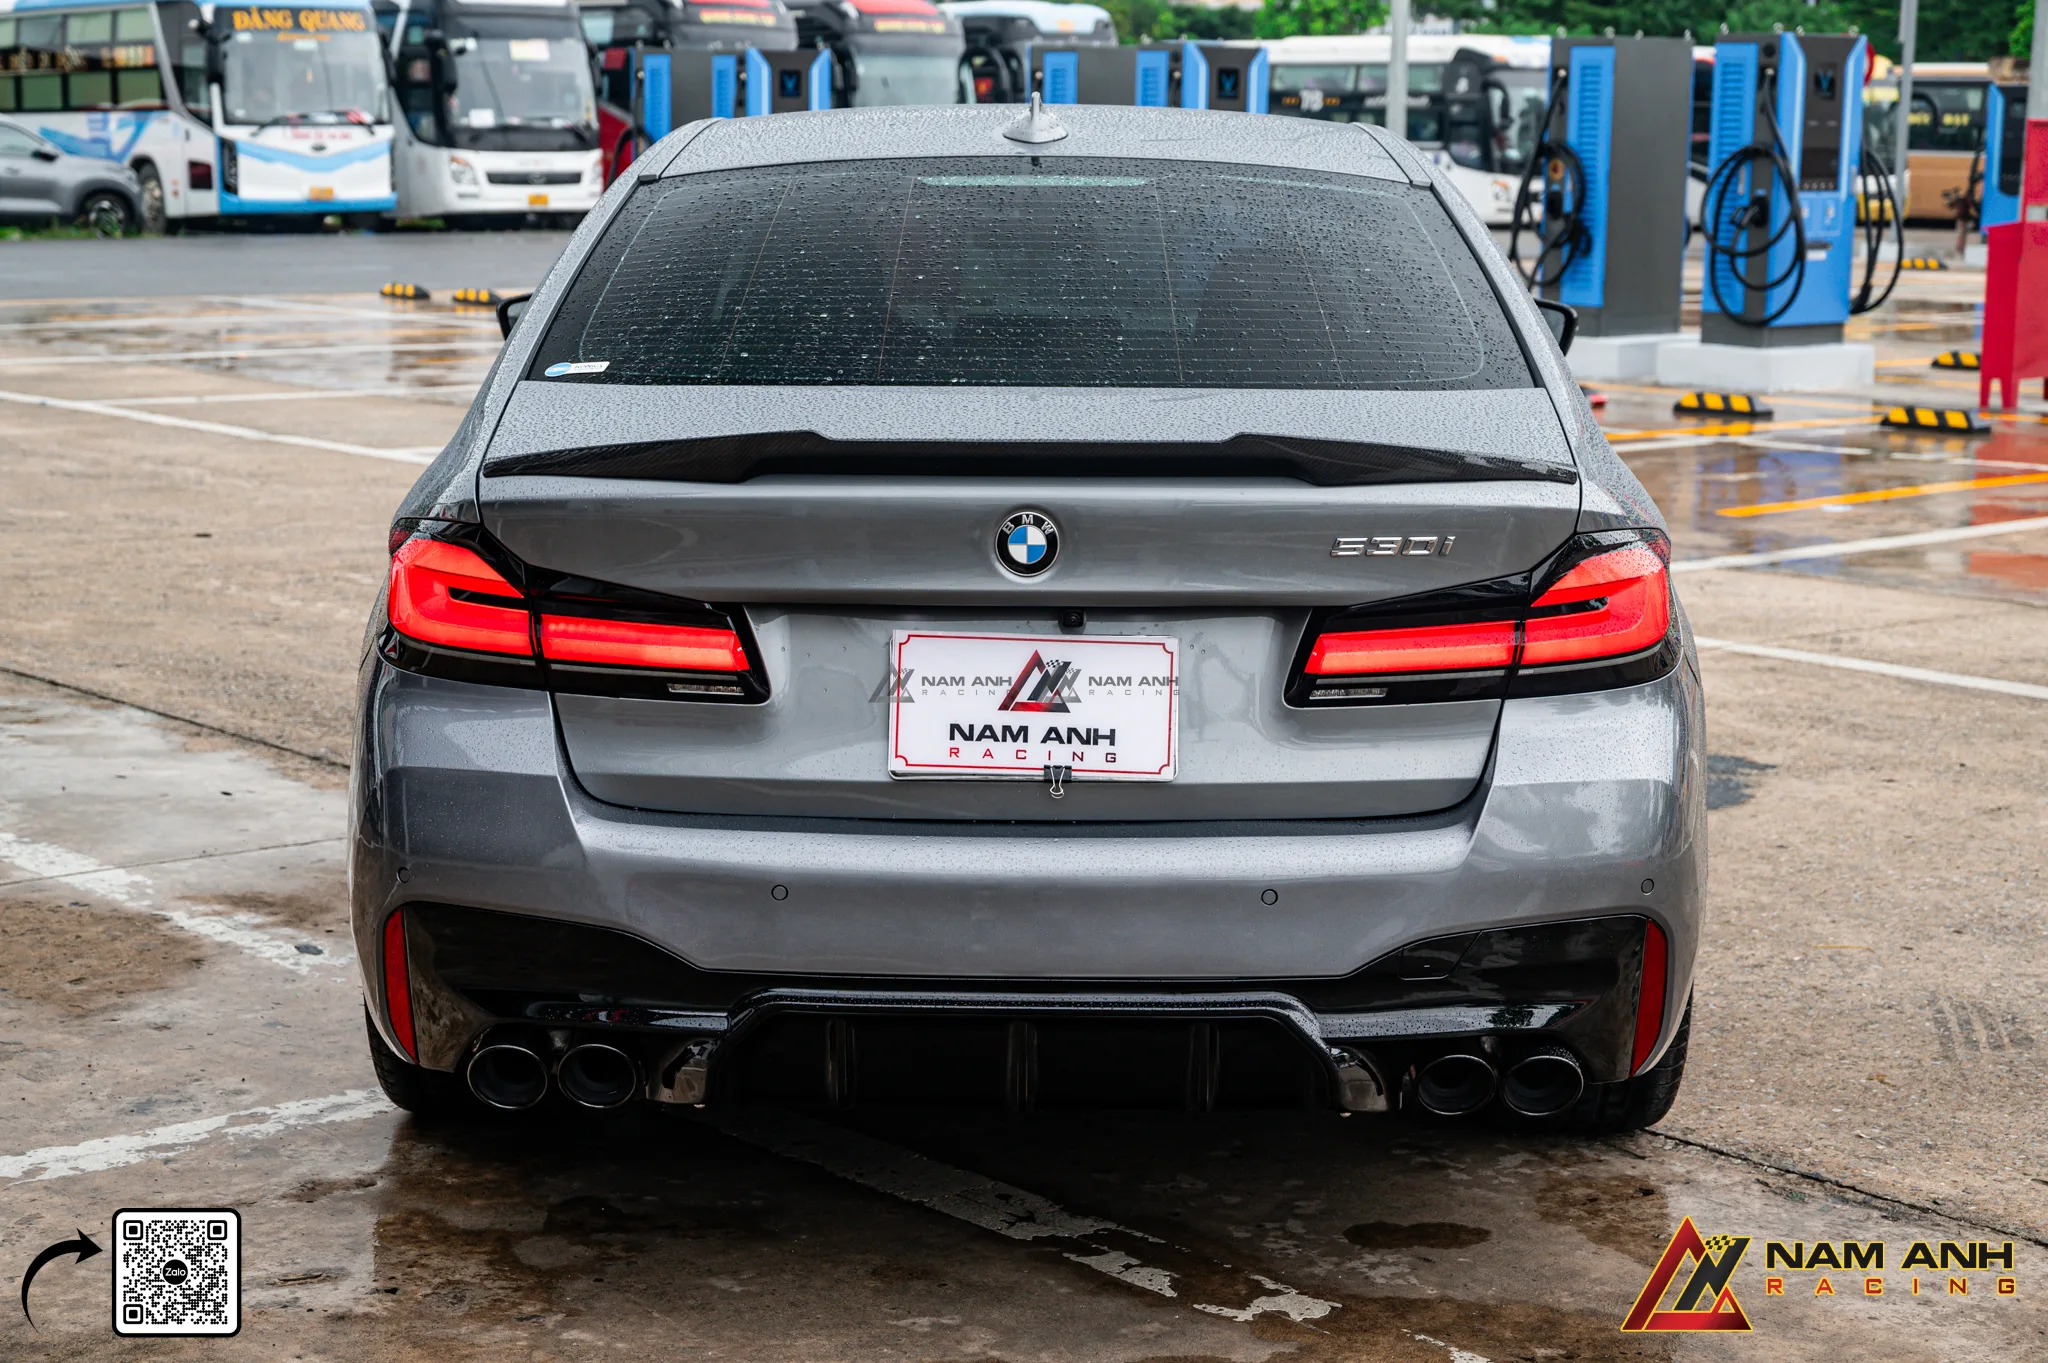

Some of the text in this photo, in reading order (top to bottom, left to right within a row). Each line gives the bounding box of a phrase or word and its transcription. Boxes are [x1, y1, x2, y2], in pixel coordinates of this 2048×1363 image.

[299, 9, 366, 32] QUANG
[1002, 514, 1054, 535] BMW
[1330, 536, 1456, 557] 530i
[949, 723, 1116, 747] NAM ANH
[949, 747, 1117, 763] RACING
